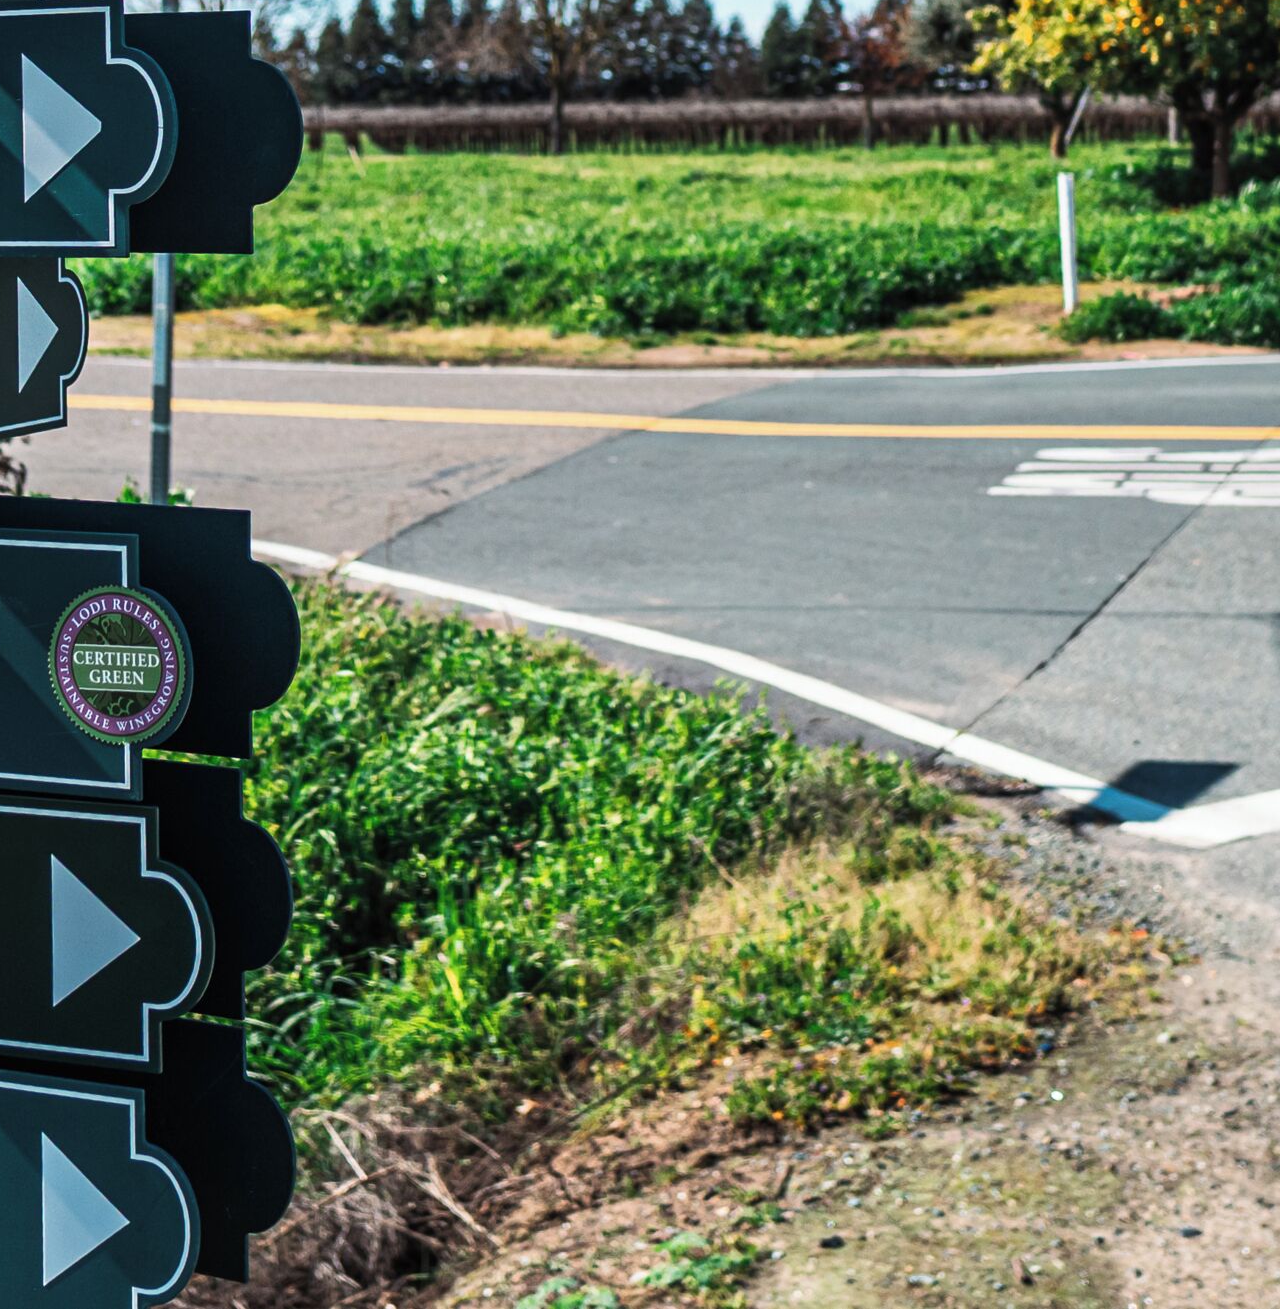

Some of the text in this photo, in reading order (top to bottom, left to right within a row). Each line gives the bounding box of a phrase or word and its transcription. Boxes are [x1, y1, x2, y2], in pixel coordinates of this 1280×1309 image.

[71, 599, 160, 630] LODI RULES
[73, 650, 160, 668] CERTIFIED
[60, 634, 175, 731] SUSTAINABLE WINEGROWING
[89, 669, 145, 685] GREEN
